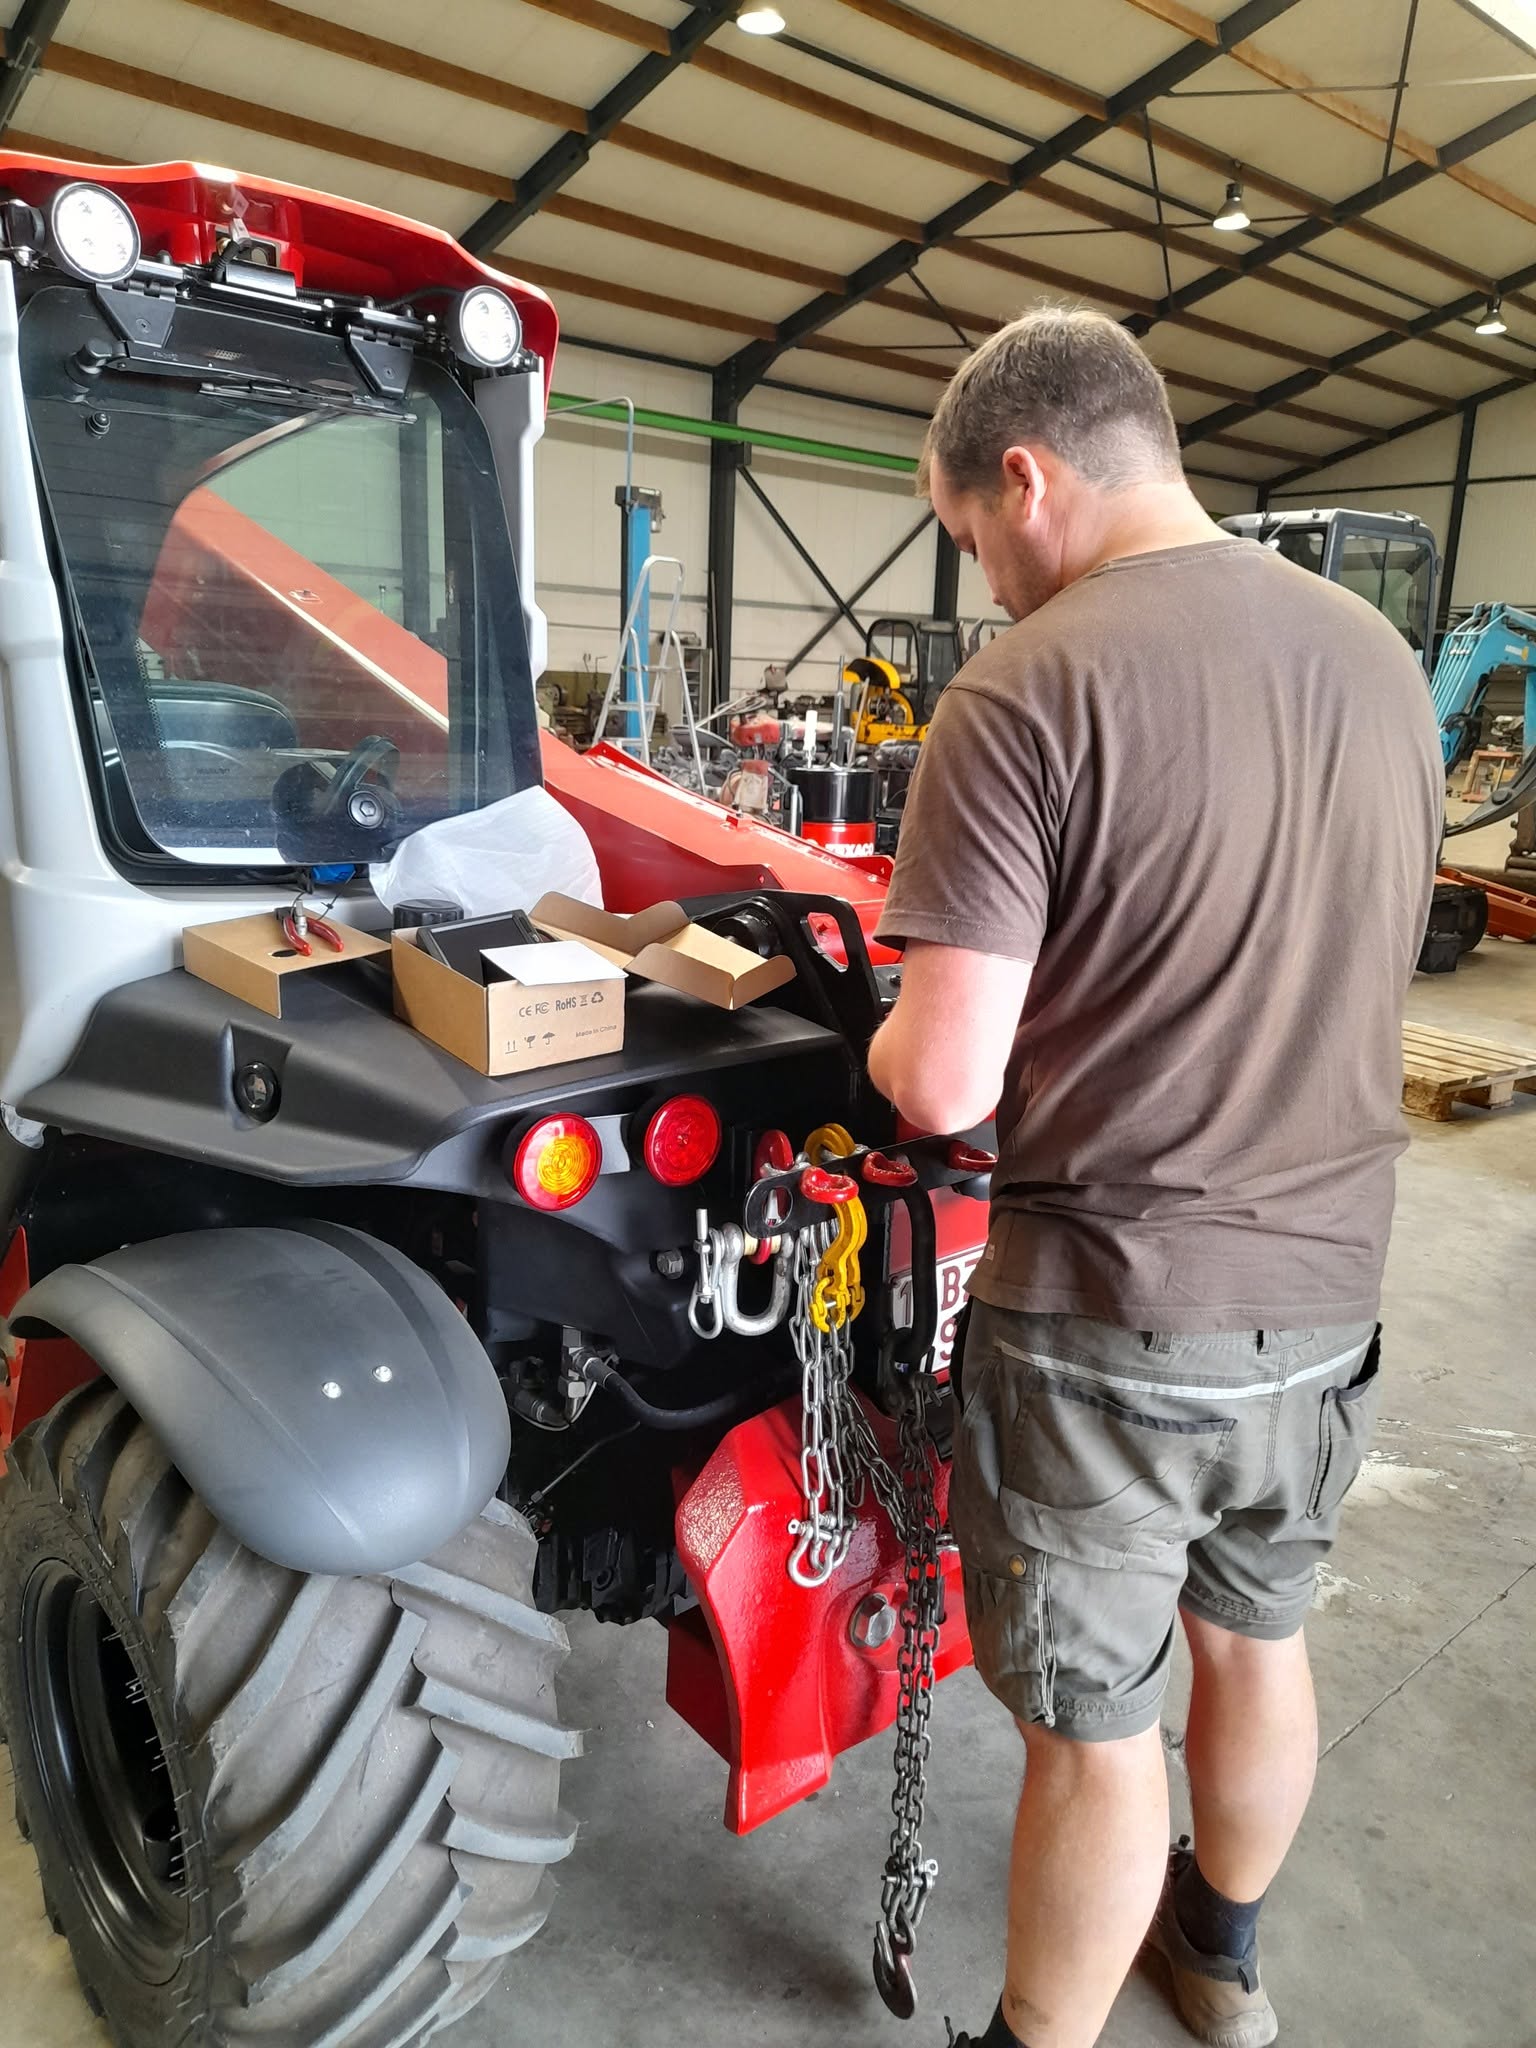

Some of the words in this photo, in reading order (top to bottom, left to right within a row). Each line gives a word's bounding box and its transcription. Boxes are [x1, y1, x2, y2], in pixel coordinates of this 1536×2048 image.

[555, 997, 577, 1011] RoHS
[575, 1029, 592, 1037] Made
[599, 1024, 617, 1032] China
